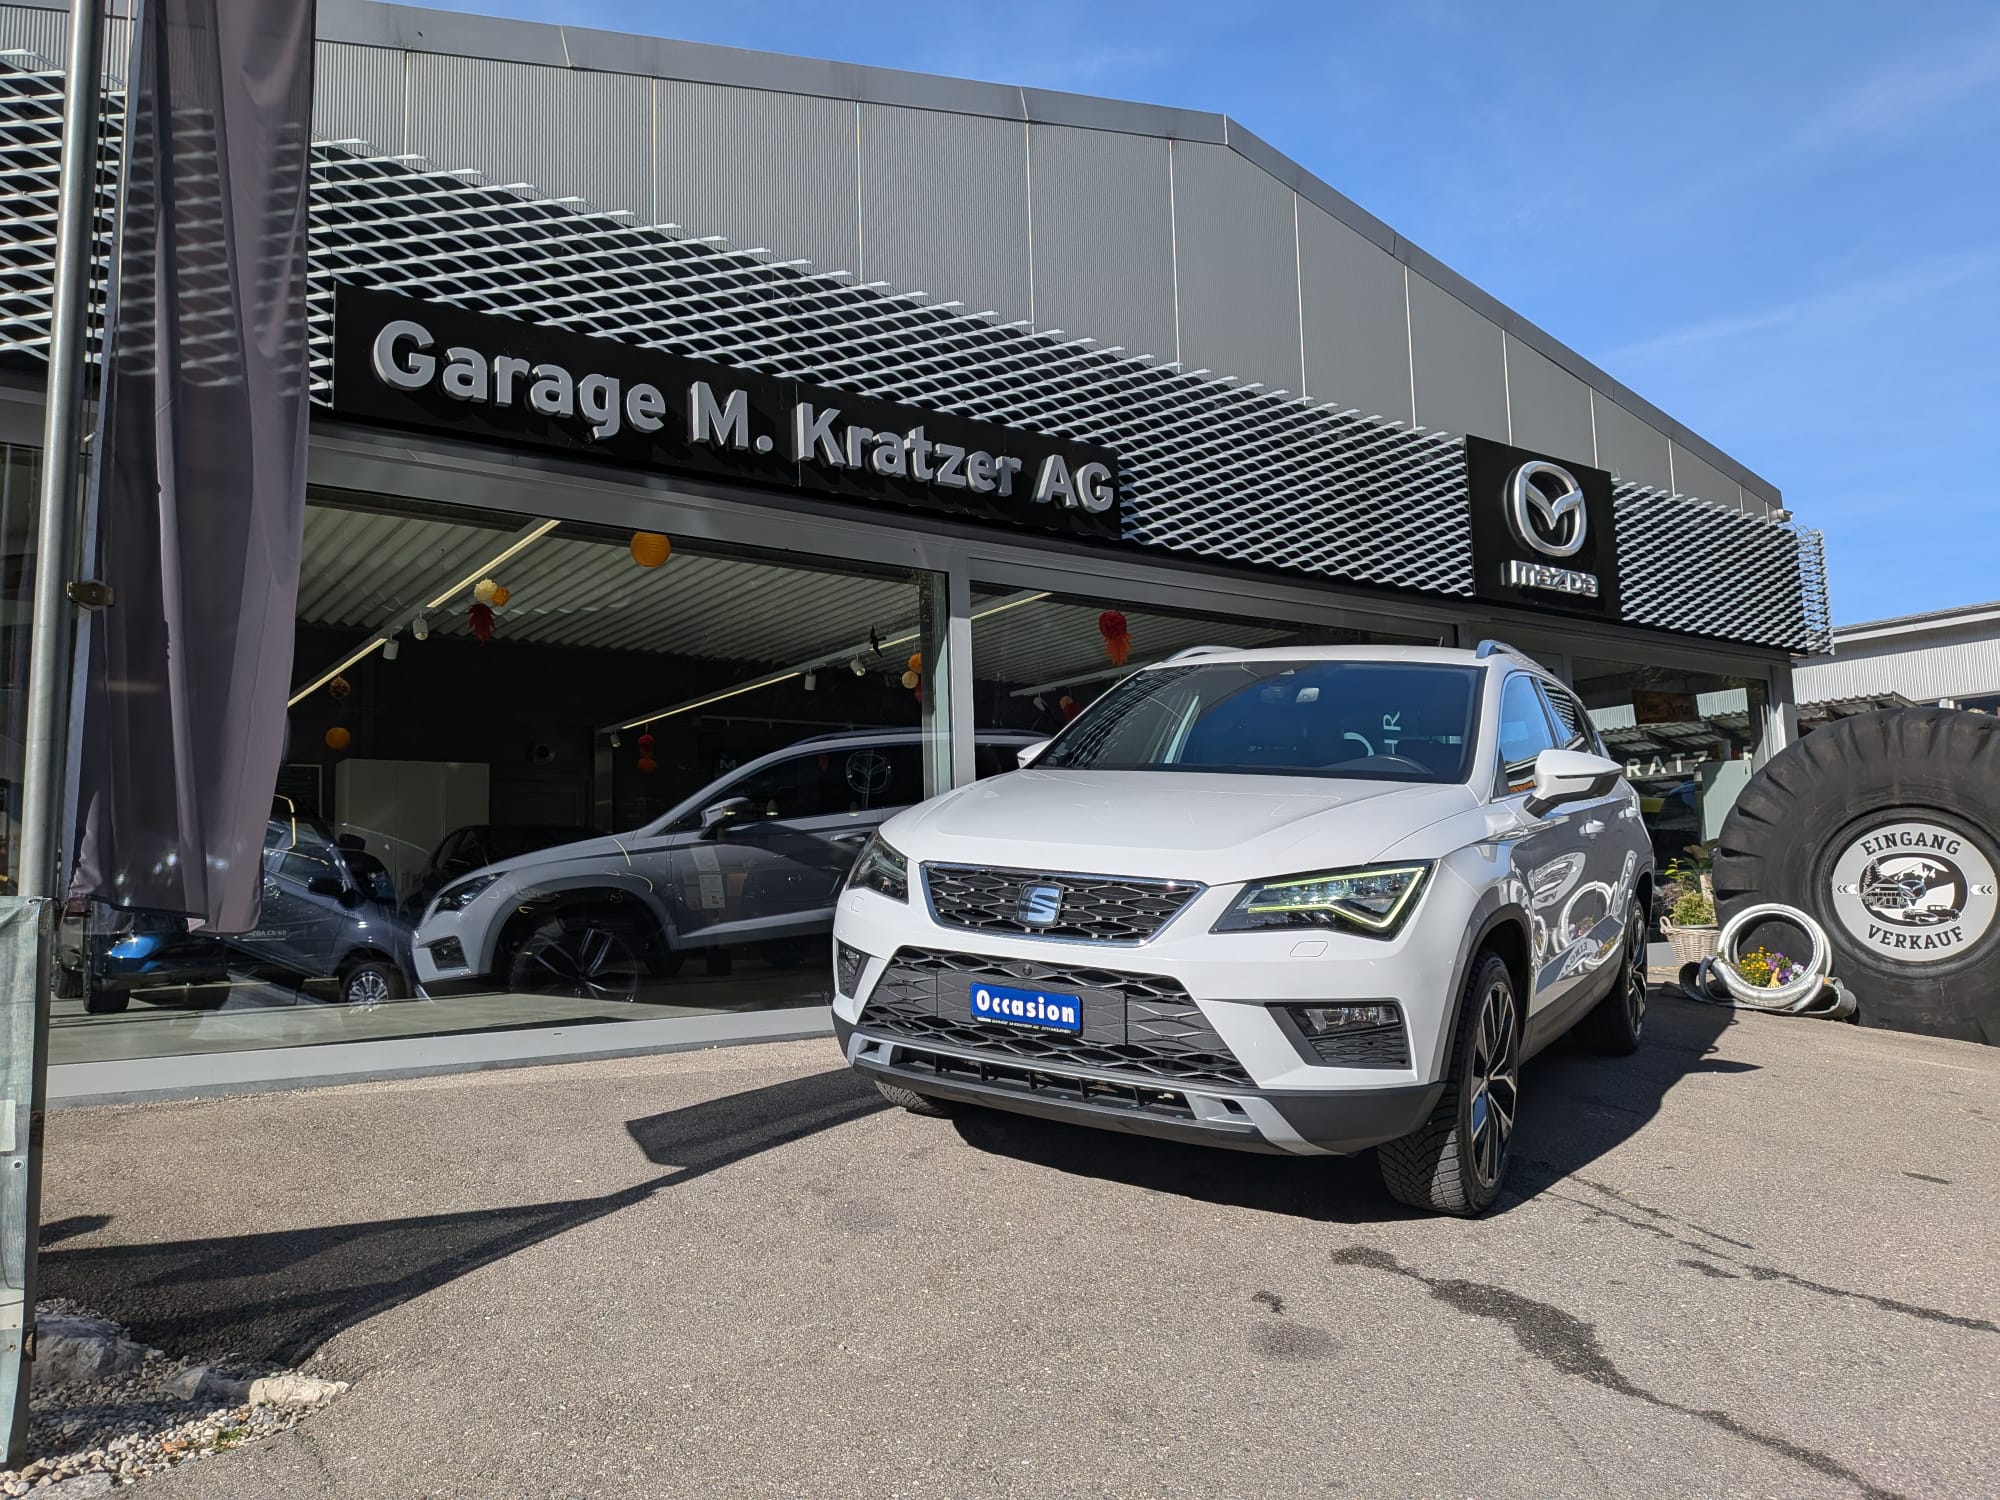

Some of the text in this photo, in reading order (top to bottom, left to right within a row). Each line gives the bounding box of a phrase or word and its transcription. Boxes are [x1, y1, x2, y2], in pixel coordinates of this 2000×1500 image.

[373, 320, 1114, 513] Garage M. Kratzer AG
[1860, 831, 1961, 856] EINGANG
[1868, 924, 1964, 950] VERKAUF
[976, 989, 1075, 1024] Occasion
